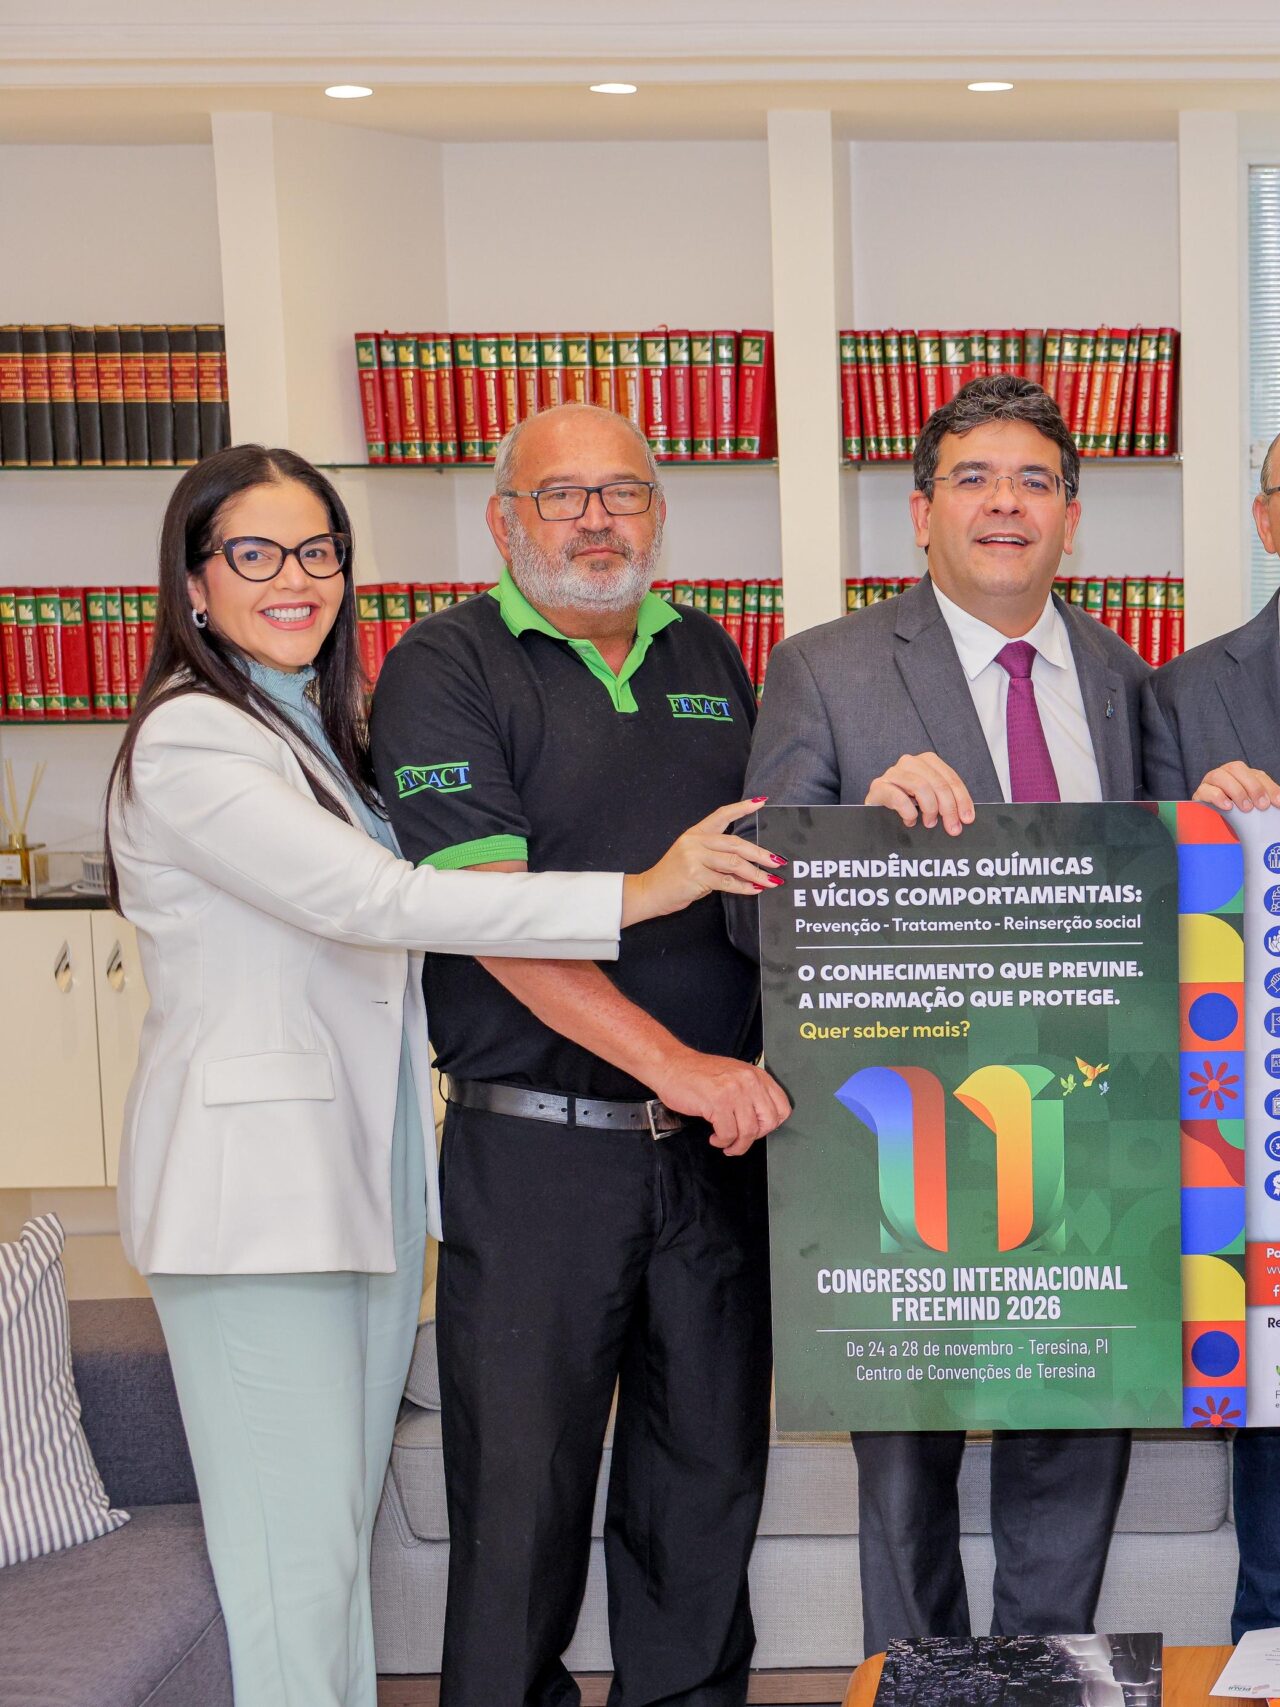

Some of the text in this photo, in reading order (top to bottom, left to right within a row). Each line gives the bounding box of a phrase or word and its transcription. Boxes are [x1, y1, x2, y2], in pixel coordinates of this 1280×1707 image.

[668, 698, 730, 717] FENACT
[792, 850, 1094, 879] DEPENDÊNCIAS QUÍMICAS
[793, 884, 1143, 907] E VÍCIOS COMPORTAMENTAIS:
[795, 918, 881, 935] Prevenção
[891, 917, 992, 932] Tratamento
[1004, 915, 1093, 934] Reinserção
[1095, 914, 1141, 929] social
[797, 960, 1144, 982] O CONHECIMENTO QUE PREVINE.
[798, 986, 1121, 1013] A INFORMAÇÃO QUE PROTEGE.
[799, 1020, 971, 1040] Quer saber mais?
[817, 1265, 1128, 1294] CONGRESSO INTERNACIONAL
[891, 1295, 1061, 1322] FREEMIND 2026
[846, 1341, 864, 1358] De
[868, 1341, 885, 1357] 24
[889, 1344, 898, 1357] a
[901, 1340, 919, 1357] 28
[923, 1340, 940, 1357] de
[944, 1340, 1014, 1356] novembro
[1028, 1339, 1091, 1356] Teresina,
[1096, 1338, 1108, 1354] PI
[856, 1362, 1096, 1383] Centro de Convenções de Teresina
